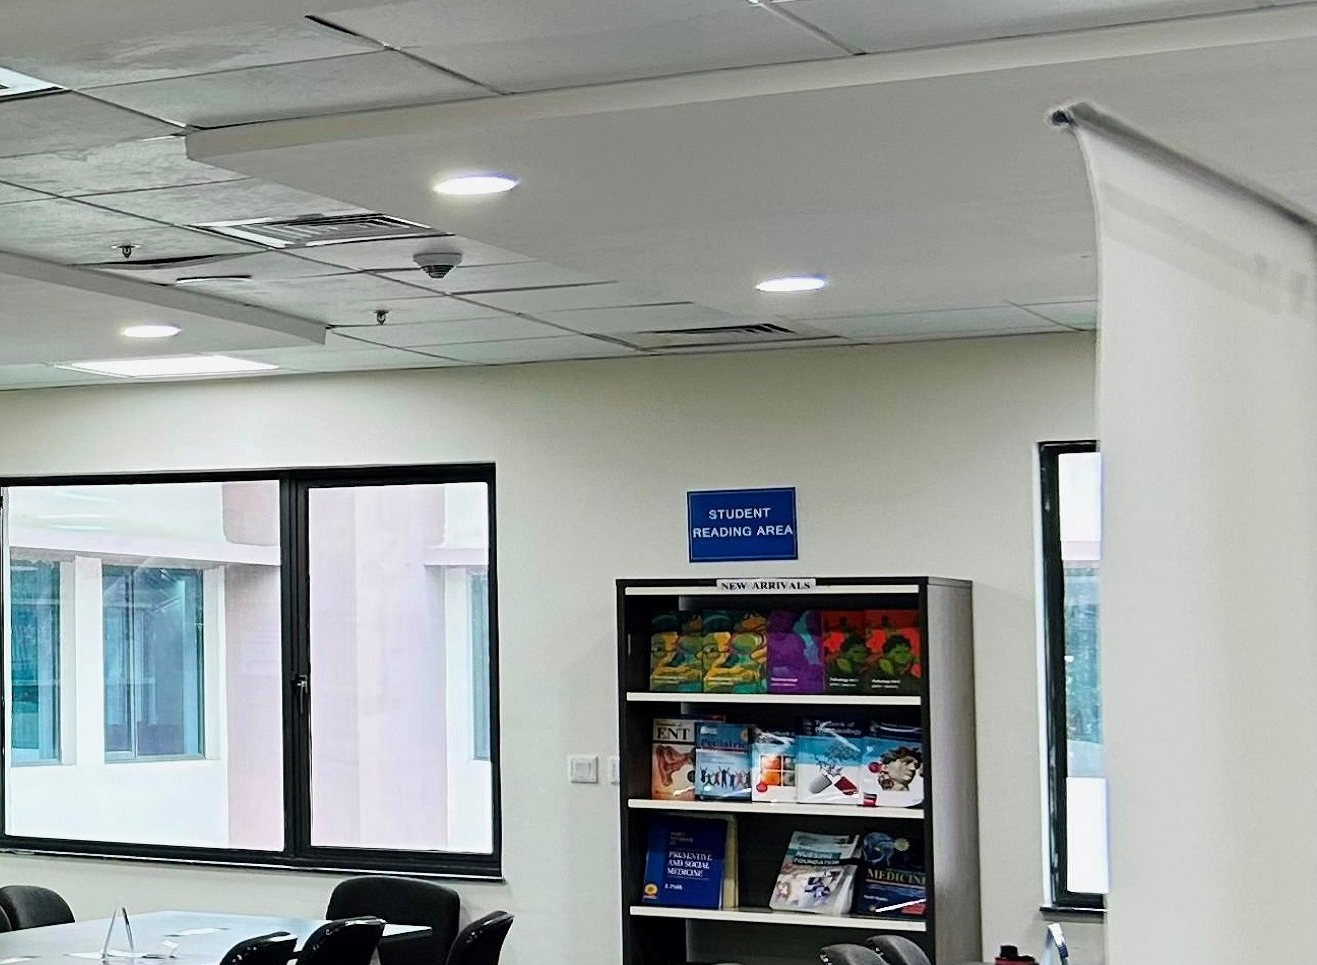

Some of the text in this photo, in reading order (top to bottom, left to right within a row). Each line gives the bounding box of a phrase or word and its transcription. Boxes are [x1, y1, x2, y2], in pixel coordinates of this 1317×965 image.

[708, 507, 771, 520] STUDENT
[692, 524, 794, 538] READING AREA
[721, 581, 811, 590] NEW ARRIVALS
[656, 727, 691, 740] ENT
[667, 859, 710, 870] AND SOCIAL
[666, 867, 703, 877] MEDICINE
